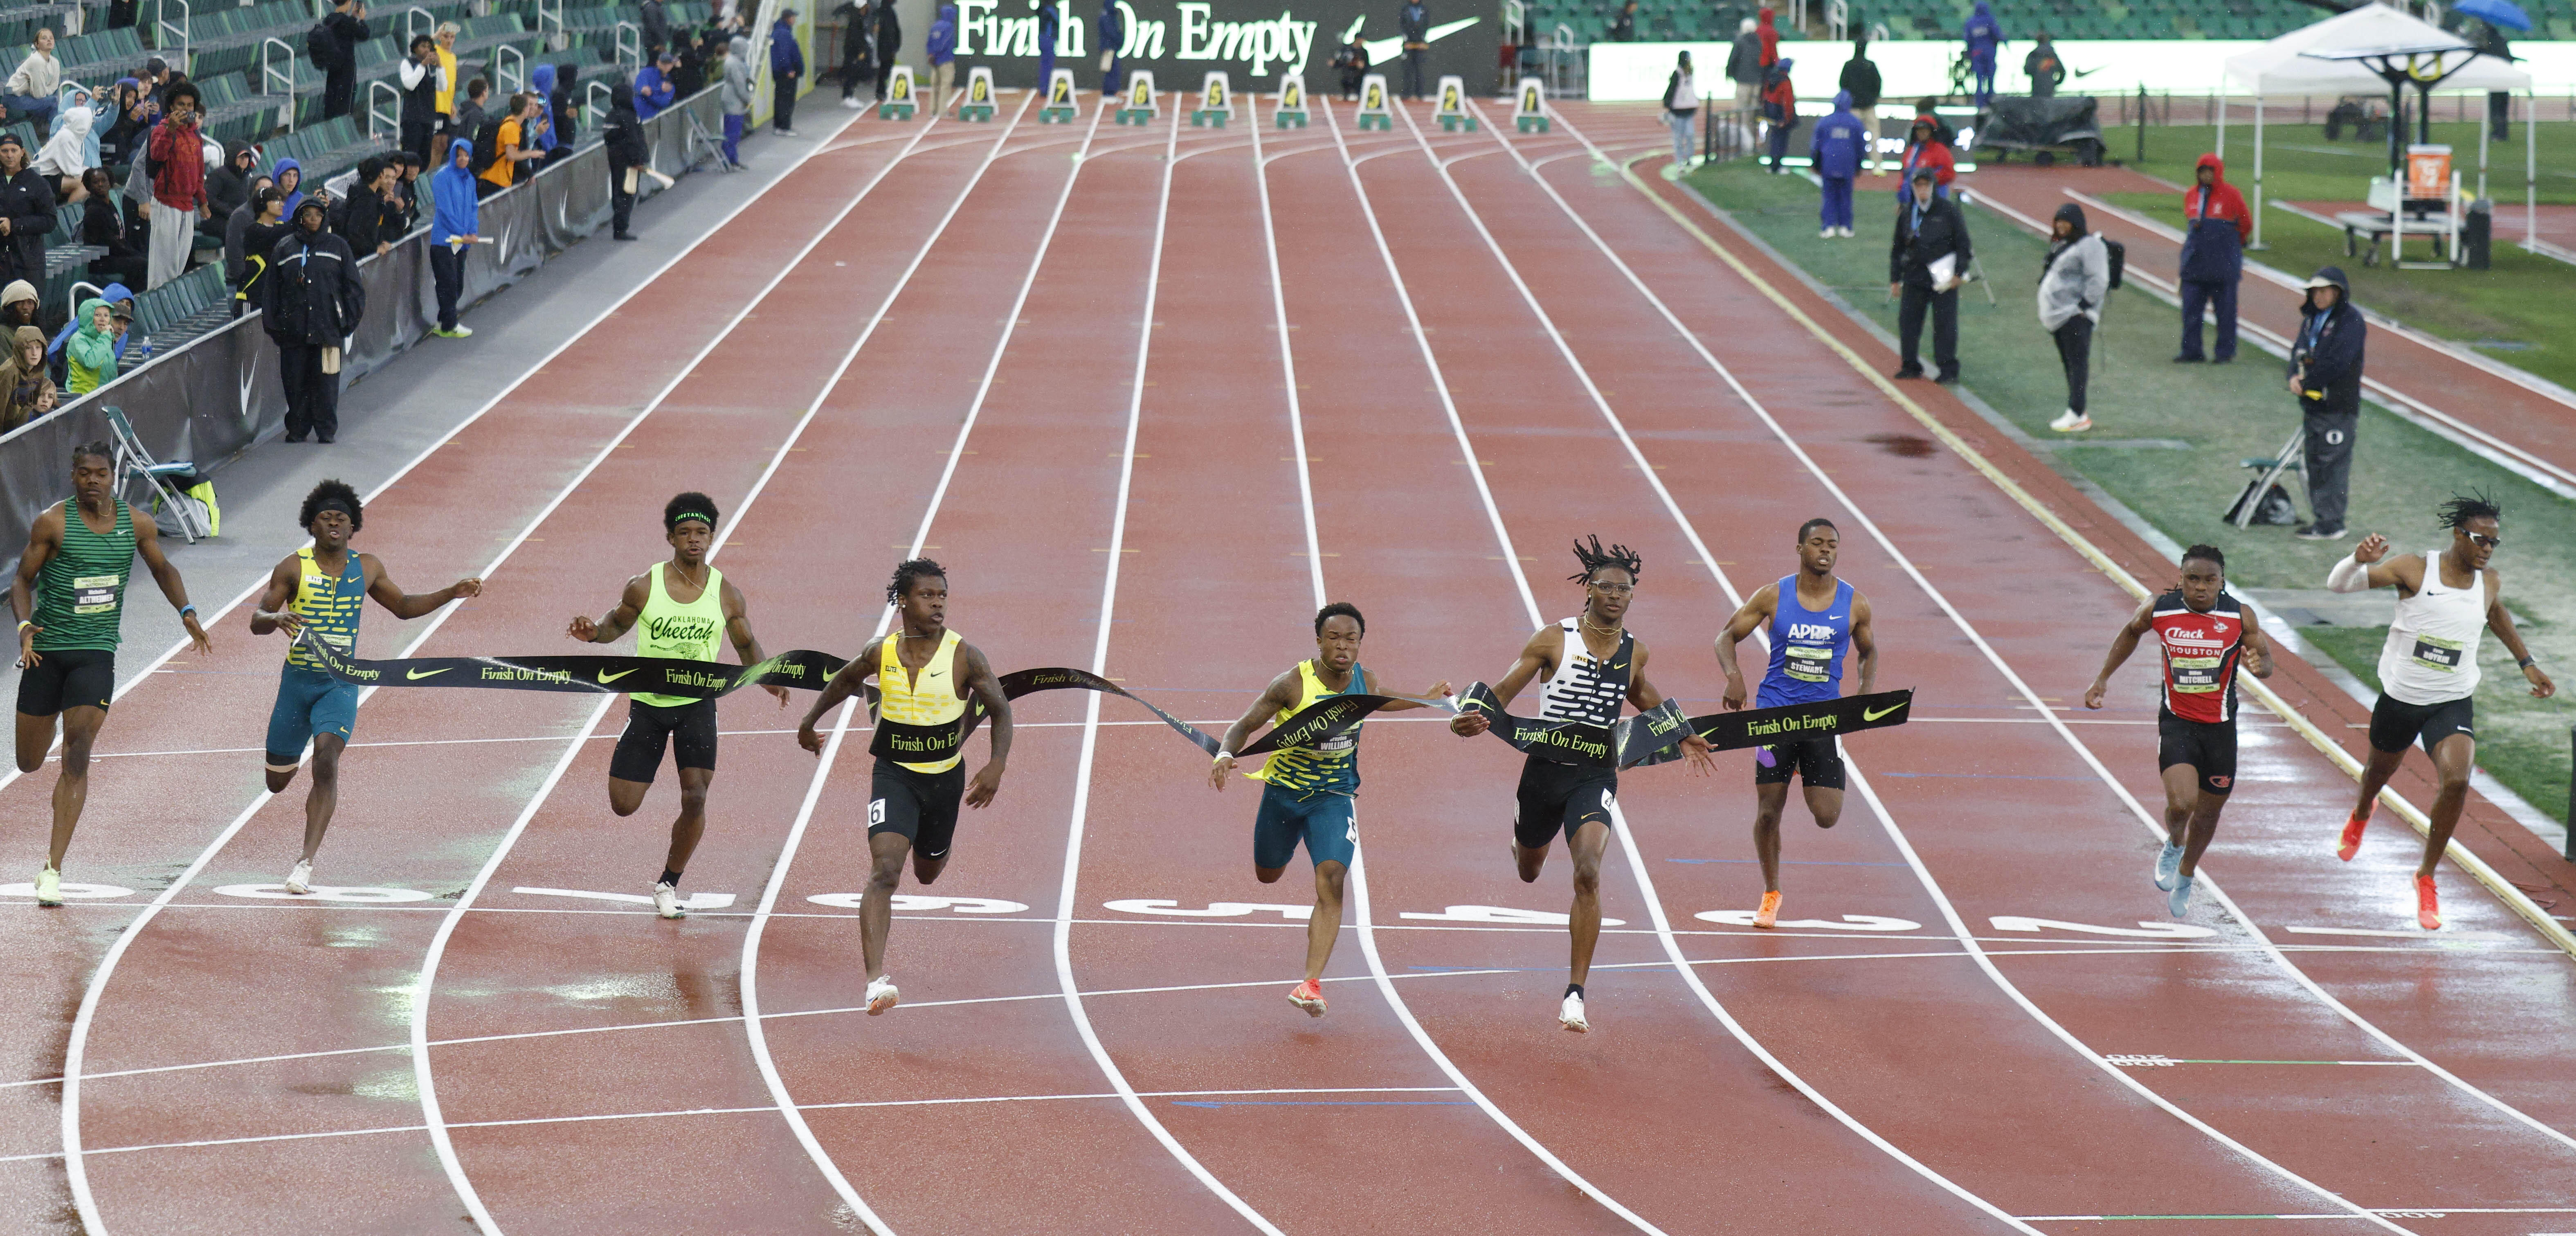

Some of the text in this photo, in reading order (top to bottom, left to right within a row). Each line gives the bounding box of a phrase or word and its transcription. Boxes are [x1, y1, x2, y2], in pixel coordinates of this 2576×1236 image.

[953, 0, 1086, 57] Finih
[1175, 2, 1318, 77] Empty
[894, 79, 906, 99] 9
[973, 81, 986, 101] 8
[1054, 83, 1068, 103] 7
[1209, 84, 1222, 106] 5
[1285, 88, 1298, 108] 4
[1366, 86, 1379, 108] 3
[1444, 89, 1457, 110] 2
[1526, 88, 1535, 111] 1
[79, 594, 114, 604] ALTHEIMER
[651, 617, 715, 640] Cheetah
[673, 616, 710, 624] OKLAHOMA
[2165, 627, 2205, 639] Track
[308, 633, 381, 680] Finish On Empty
[2169, 646, 2221, 656] HOUSTON
[481, 667, 572, 684] Finish On Empty
[781, 660, 806, 679] Empty
[1791, 662, 1823, 674] STEWART
[665, 669, 728, 691] Finish On Empty
[1032, 674, 1065, 685] Finish
[2179, 675, 2213, 684] MITCHELL
[1276, 700, 1360, 750] Finish On Empty
[1647, 716, 1679, 736] Finish
[1747, 714, 1838, 736] Finish On Empty
[891, 734, 924, 751] Finish
[927, 736, 946, 751] On
[1320, 739, 1353, 750] WILLIAMS
[1514, 727, 1609, 759] Finish On Empty
[871, 801, 880, 823] 6
[212, 883, 434, 903] 8
[806, 893, 1030, 913] 6
[1103, 899, 1315, 920] 5
[1399, 905, 1627, 926] 4
[1693, 910, 1922, 932] 3
[1988, 916, 2217, 938] 2
